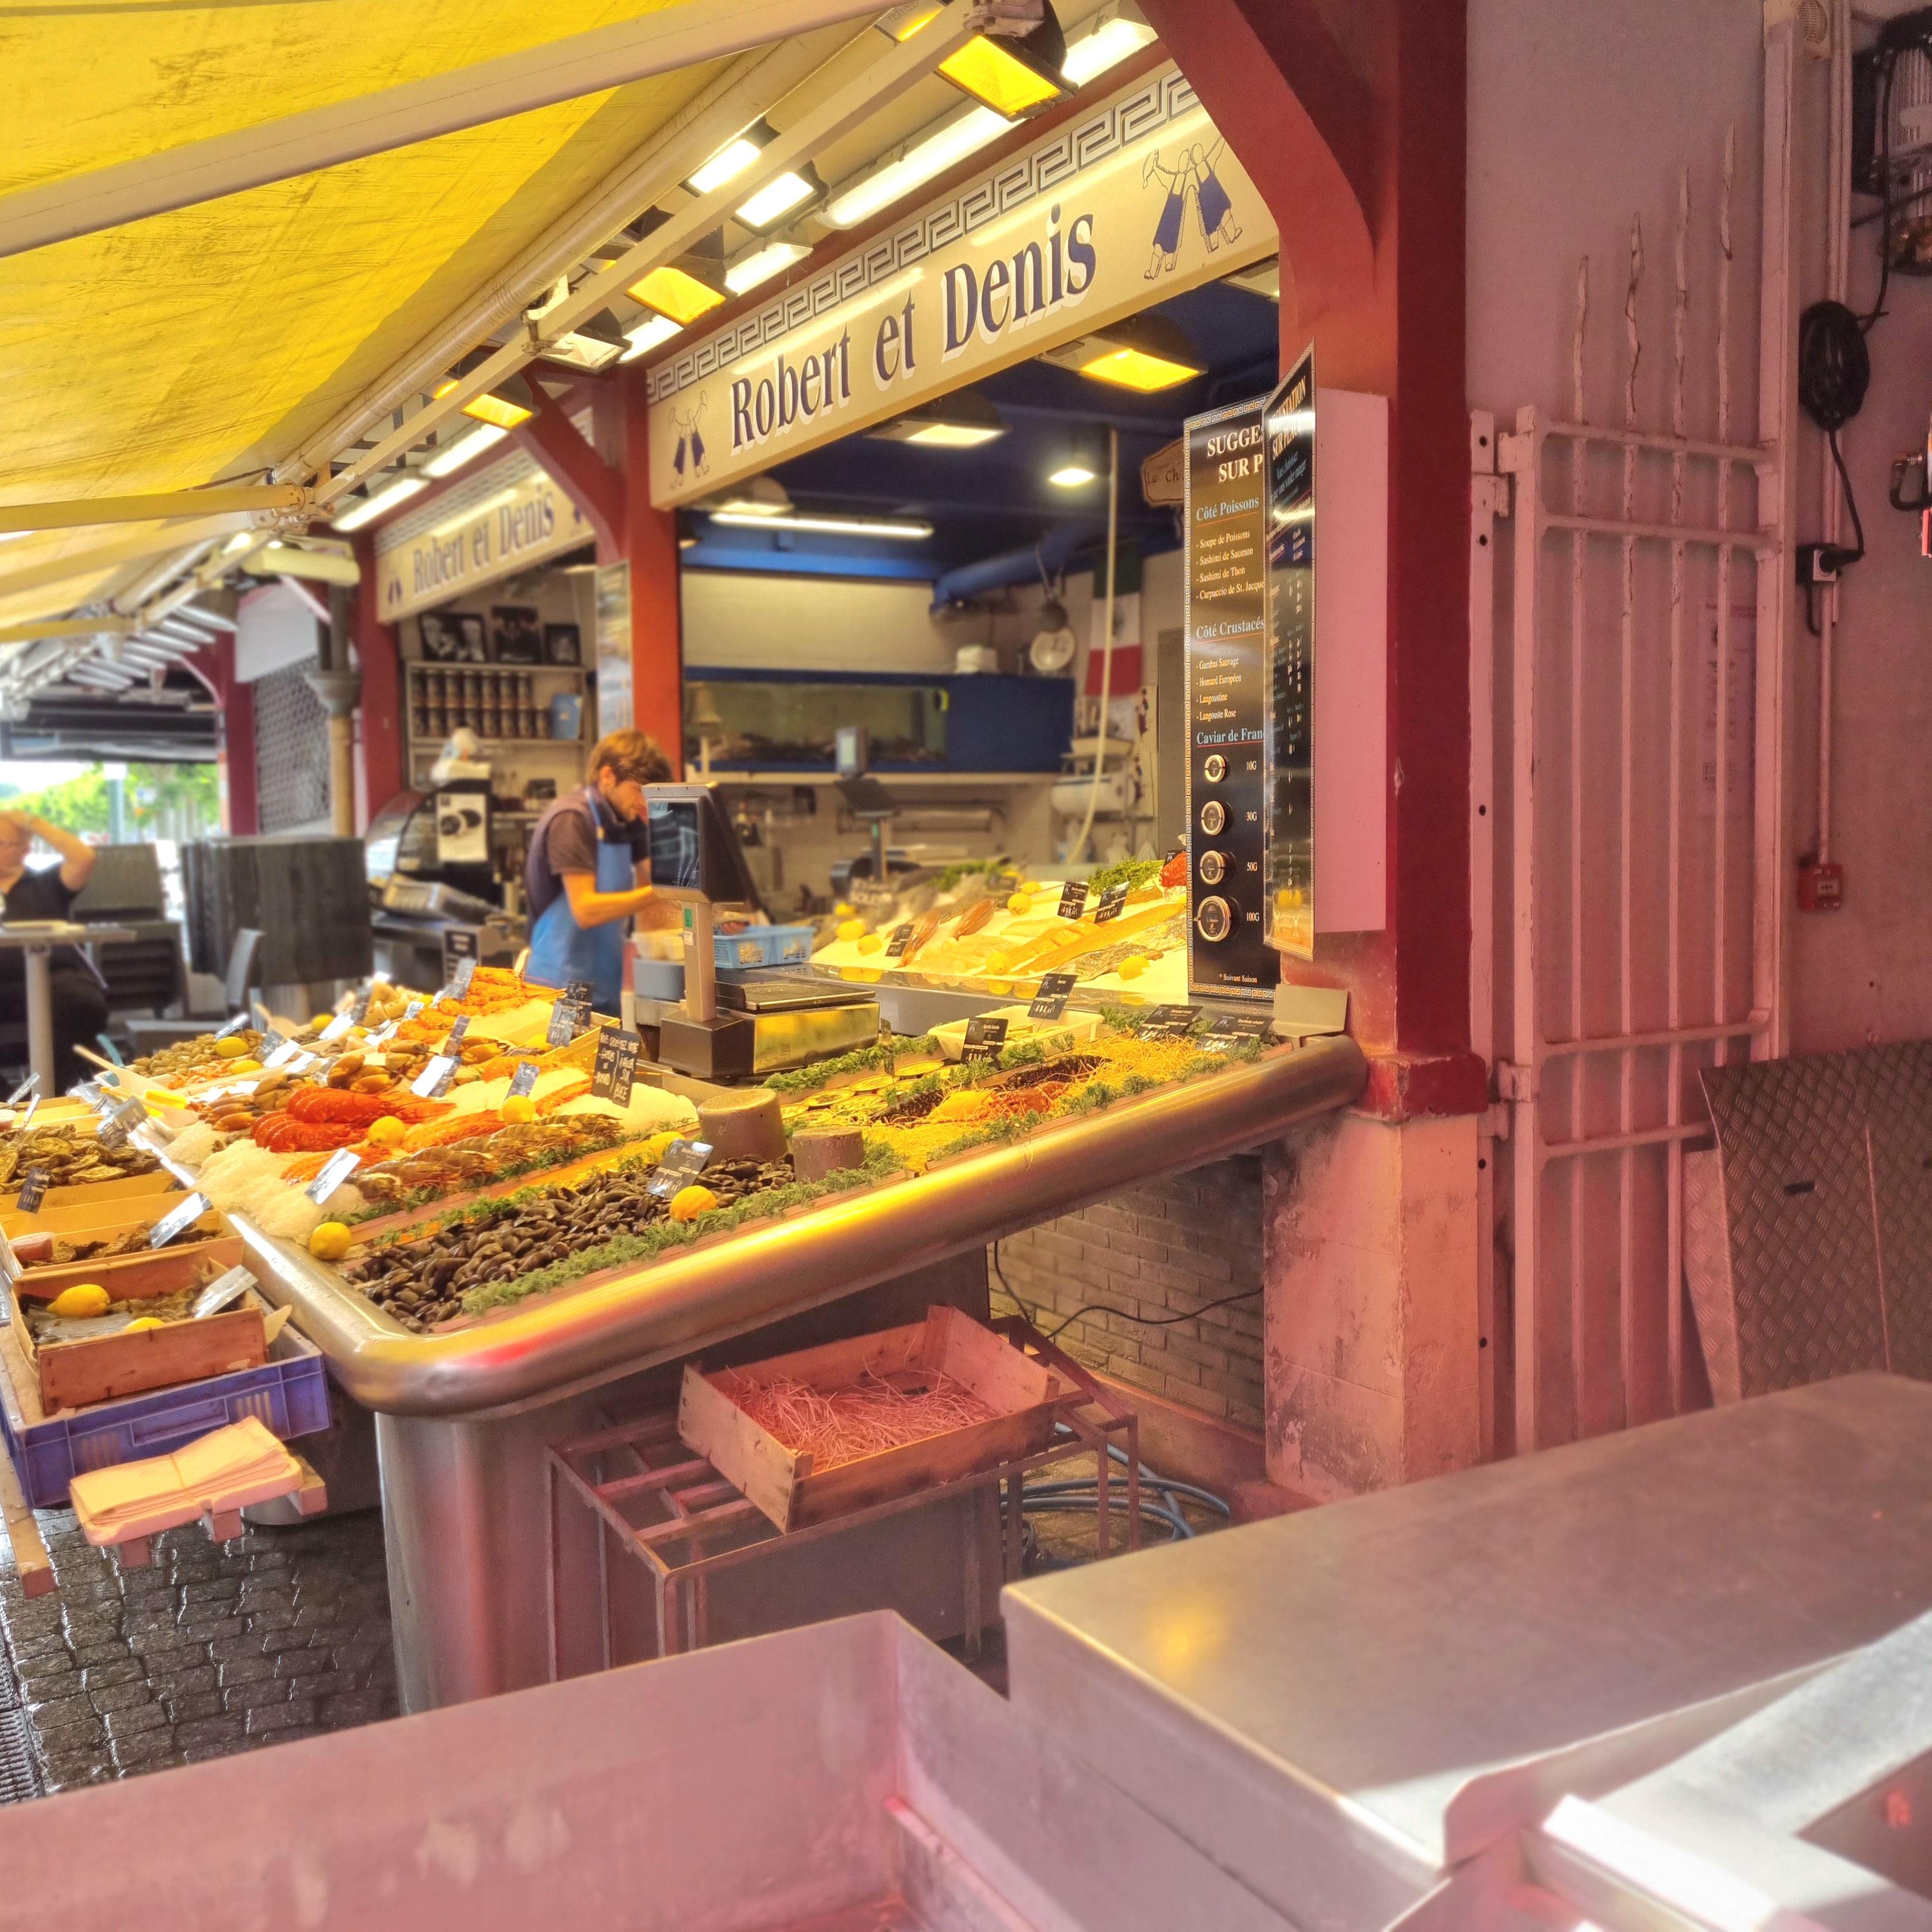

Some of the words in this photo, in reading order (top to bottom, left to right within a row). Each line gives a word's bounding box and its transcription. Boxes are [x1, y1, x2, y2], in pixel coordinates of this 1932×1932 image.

[731, 324, 851, 451] Robert
[875, 289, 916, 385] et
[943, 203, 1097, 355] Denis
[1207, 424, 1263, 457] SUGGE
[1219, 457, 1250, 482] SUR
[1196, 503, 1218, 521] Côté
[1220, 497, 1259, 516] Poissons
[413, 532, 465, 597] Robert
[471, 521, 490, 569] et
[498, 484, 555, 559] Denis
[1200, 539, 1216, 549] Soupe
[1218, 535, 1225, 544] de
[1226, 531, 1250, 543] Poissons
[1200, 552, 1222, 565] Sashimi
[1222, 551, 1230, 560] de
[1230, 548, 1254, 558] Saumon
[1200, 569, 1222, 583] Sashimi
[1222, 568, 1230, 578] de
[1230, 567, 1245, 577] Thon
[1200, 586, 1227, 601] Carpaccio
[1228, 585, 1235, 594] de
[1236, 583, 1245, 593] St.
[1196, 624, 1217, 639] Côté
[1220, 615, 1265, 636] Crustacés
[1199, 659, 1218, 670] Gambas
[1200, 710, 1223, 722] Langouste
[1224, 709, 1236, 718] Rose
[1197, 730, 1226, 744] Caviar
[1228, 728, 1238, 742] de
[1246, 760, 1257, 770] 10G
[1246, 811, 1257, 821] 30G
[1246, 862, 1257, 871] 50G
[1246, 912, 1259, 922] 100G
[1241, 974, 1257, 983] Saison
